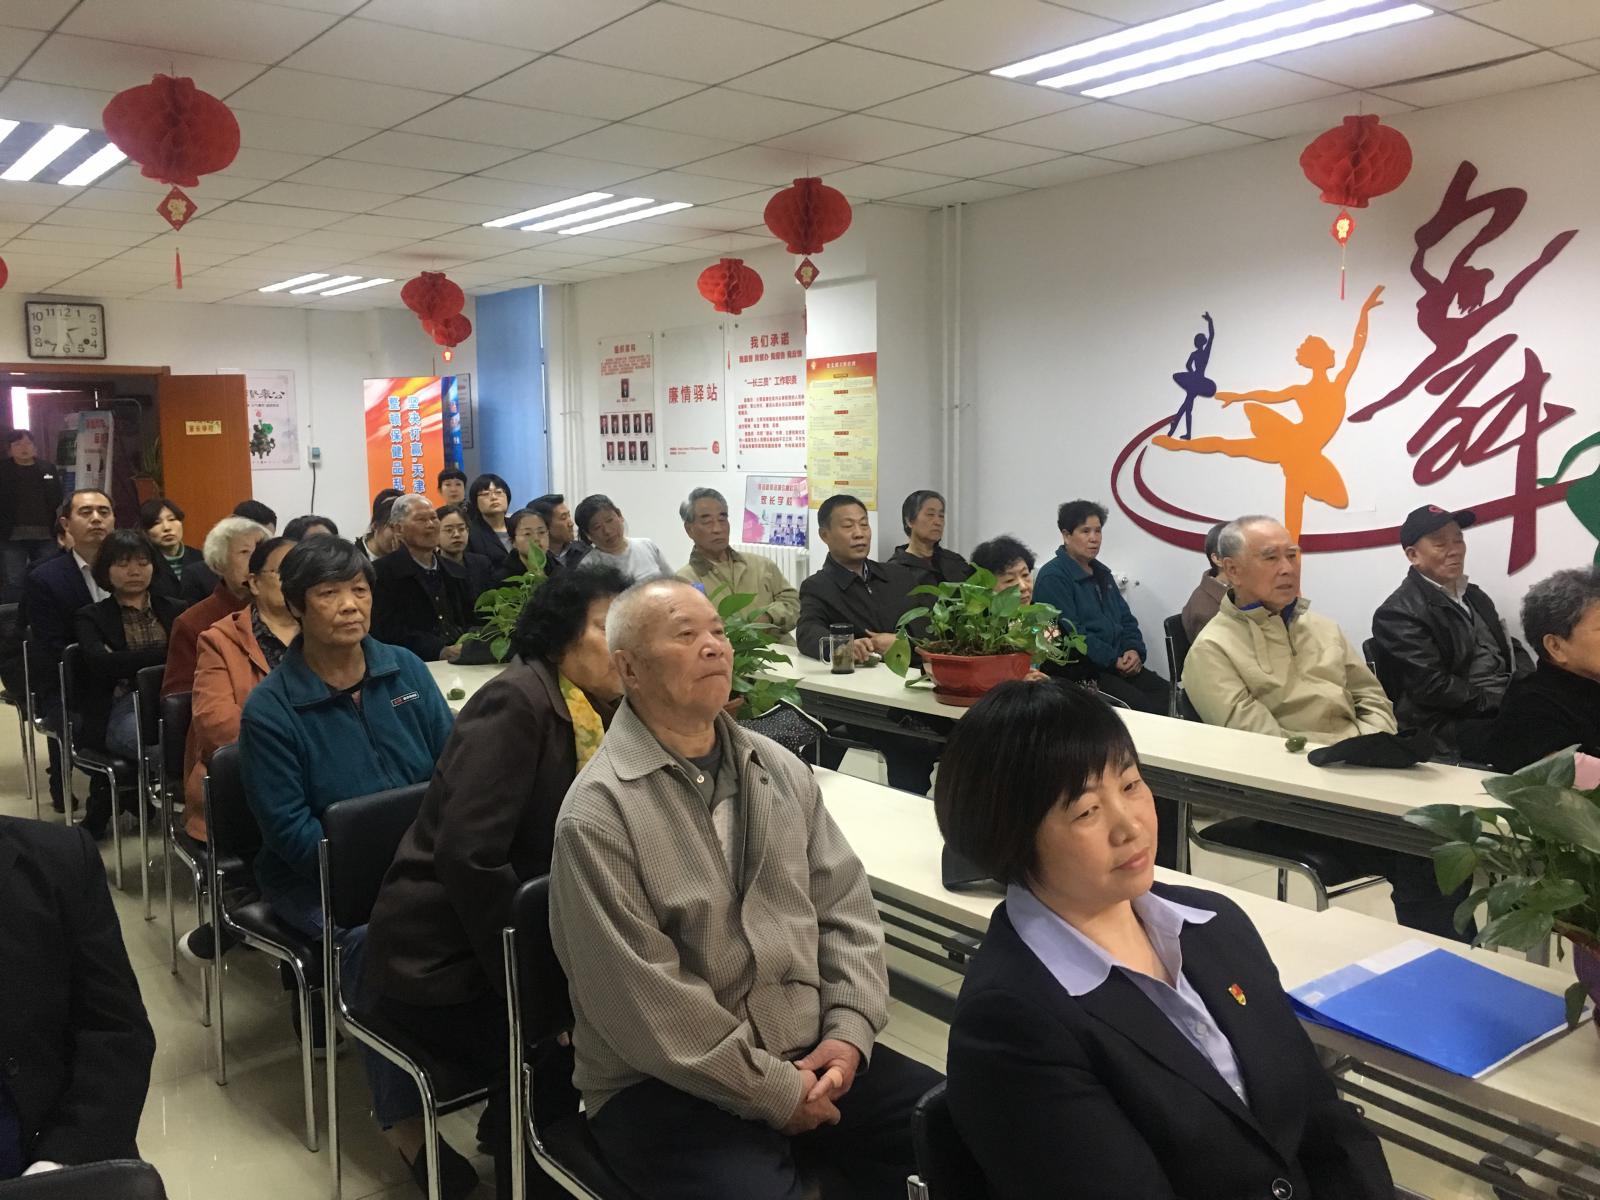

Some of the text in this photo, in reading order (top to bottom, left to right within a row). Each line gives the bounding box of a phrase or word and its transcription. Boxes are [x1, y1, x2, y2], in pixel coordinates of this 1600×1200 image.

[31, 311, 44, 322] 10
[46, 308, 55, 317] 11
[59, 307, 71, 318] 12
[88, 313, 97, 324] 2
[32, 324, 41, 335] 9
[90, 327, 98, 337] 3
[34, 337, 43, 348] 8
[90, 339, 98, 349] 4
[750, 332, 790, 349] 我们承诺
[62, 343, 71, 354] 6
[77, 342, 85, 353] 5
[668, 383, 719, 405] 廉情驿站
